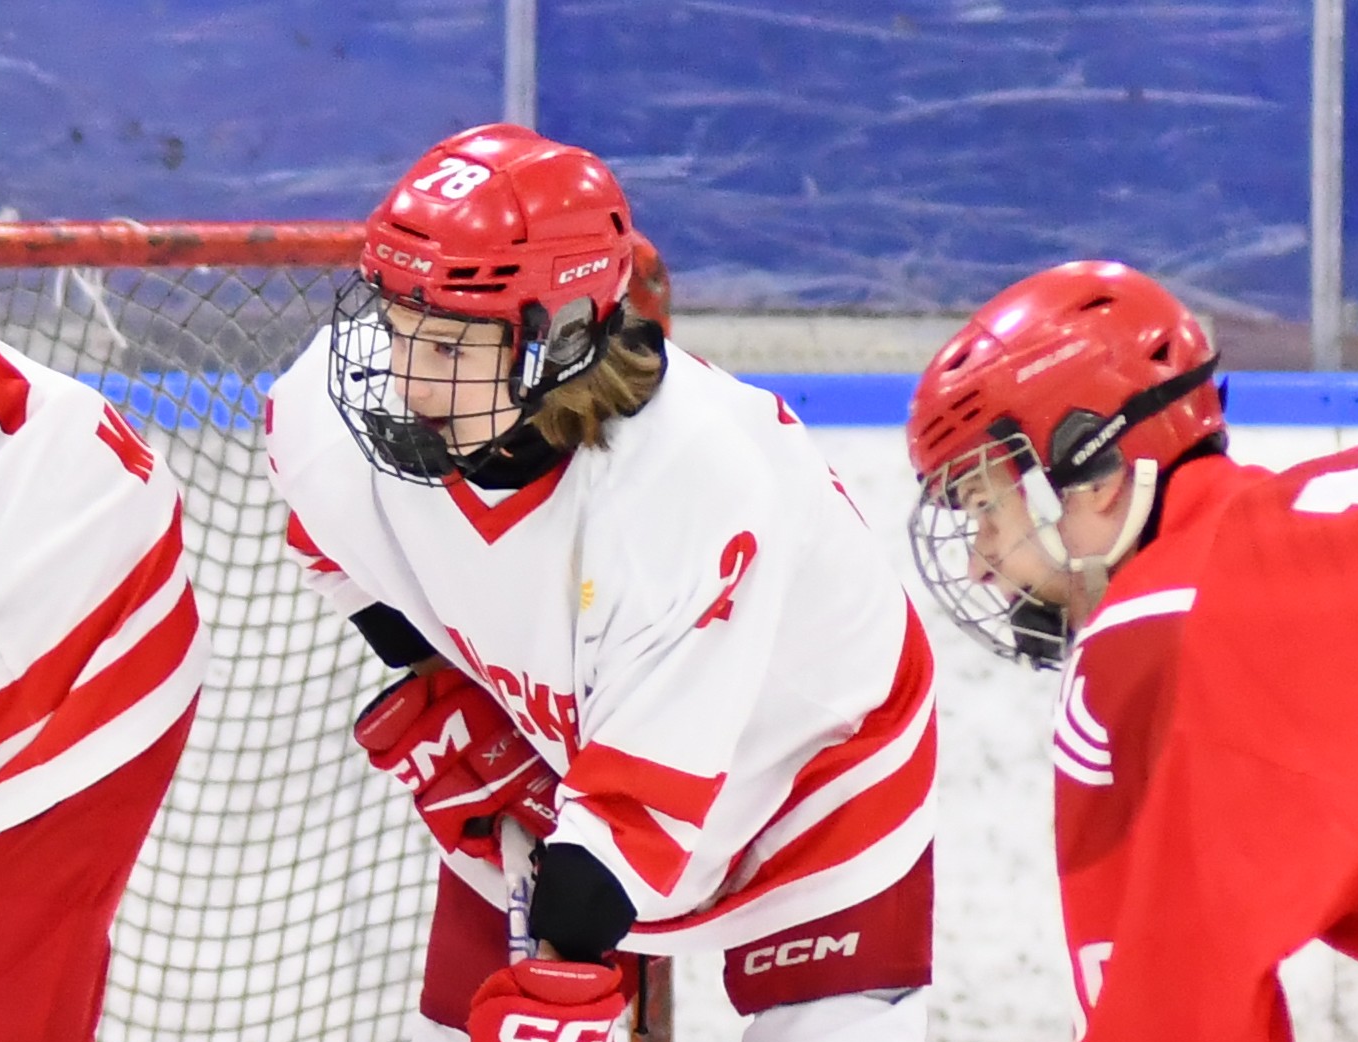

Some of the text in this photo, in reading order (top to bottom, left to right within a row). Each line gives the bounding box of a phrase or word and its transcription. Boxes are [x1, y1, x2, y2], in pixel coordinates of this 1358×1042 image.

[412, 157, 491, 200] 78
[376, 243, 434, 273] CCM
[558, 257, 610, 285] CCM
[744, 932, 861, 976] CCM
